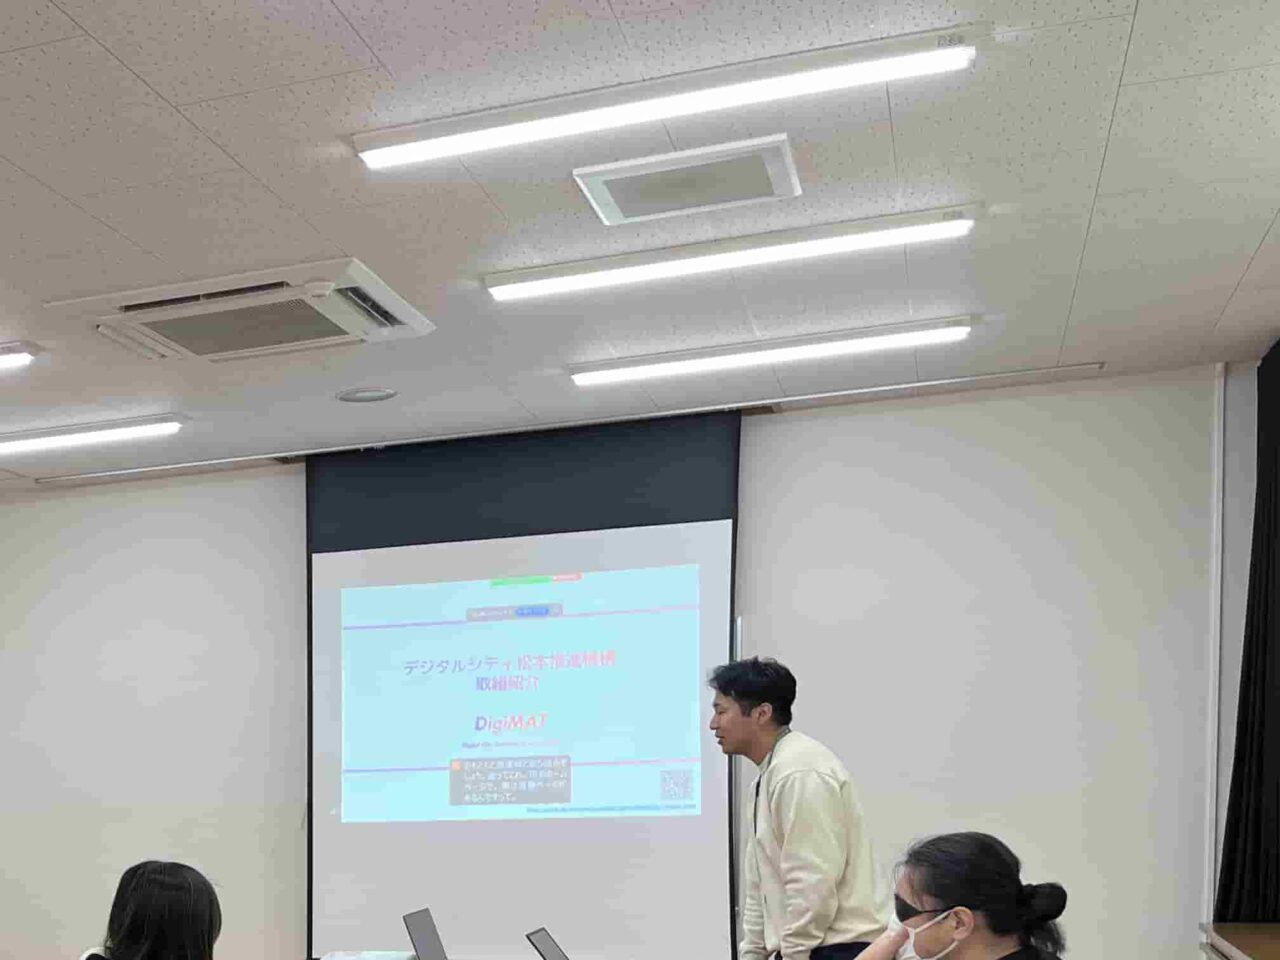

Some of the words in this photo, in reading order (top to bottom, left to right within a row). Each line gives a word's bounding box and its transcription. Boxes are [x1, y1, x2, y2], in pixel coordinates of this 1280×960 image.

[403, 650, 616, 676] デジタルシティ松本推進機構
[474, 711, 549, 735] DigiMAT
